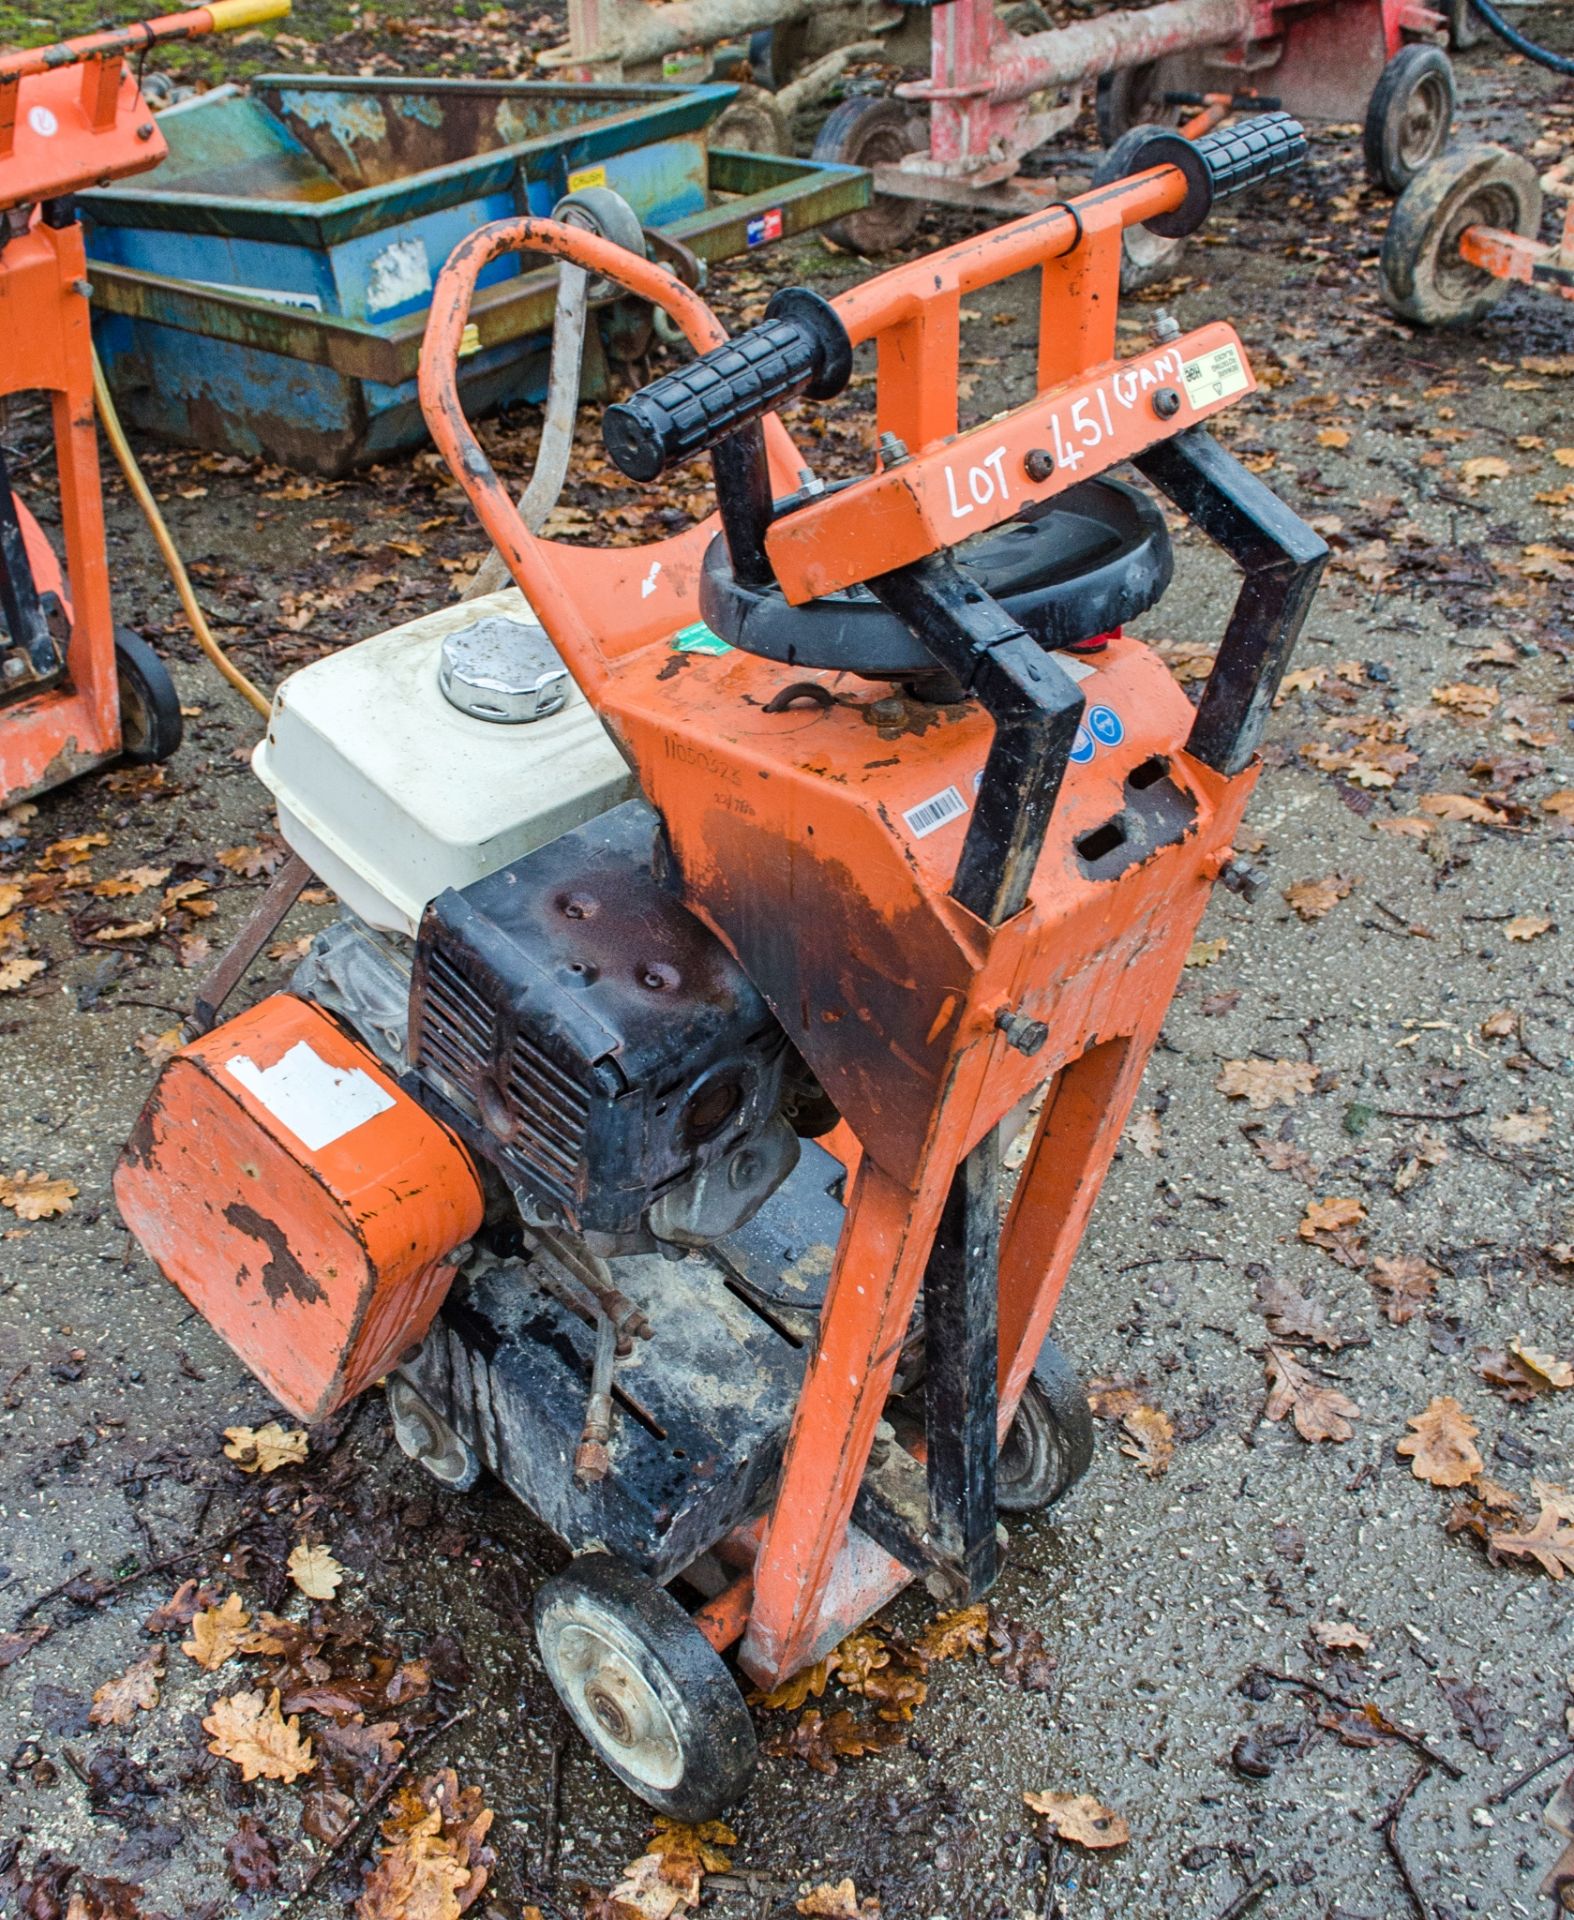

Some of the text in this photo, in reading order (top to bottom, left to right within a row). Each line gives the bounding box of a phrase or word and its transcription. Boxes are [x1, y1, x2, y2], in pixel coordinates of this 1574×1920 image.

[944, 347, 1184, 519] LOT 451 (JAN)
